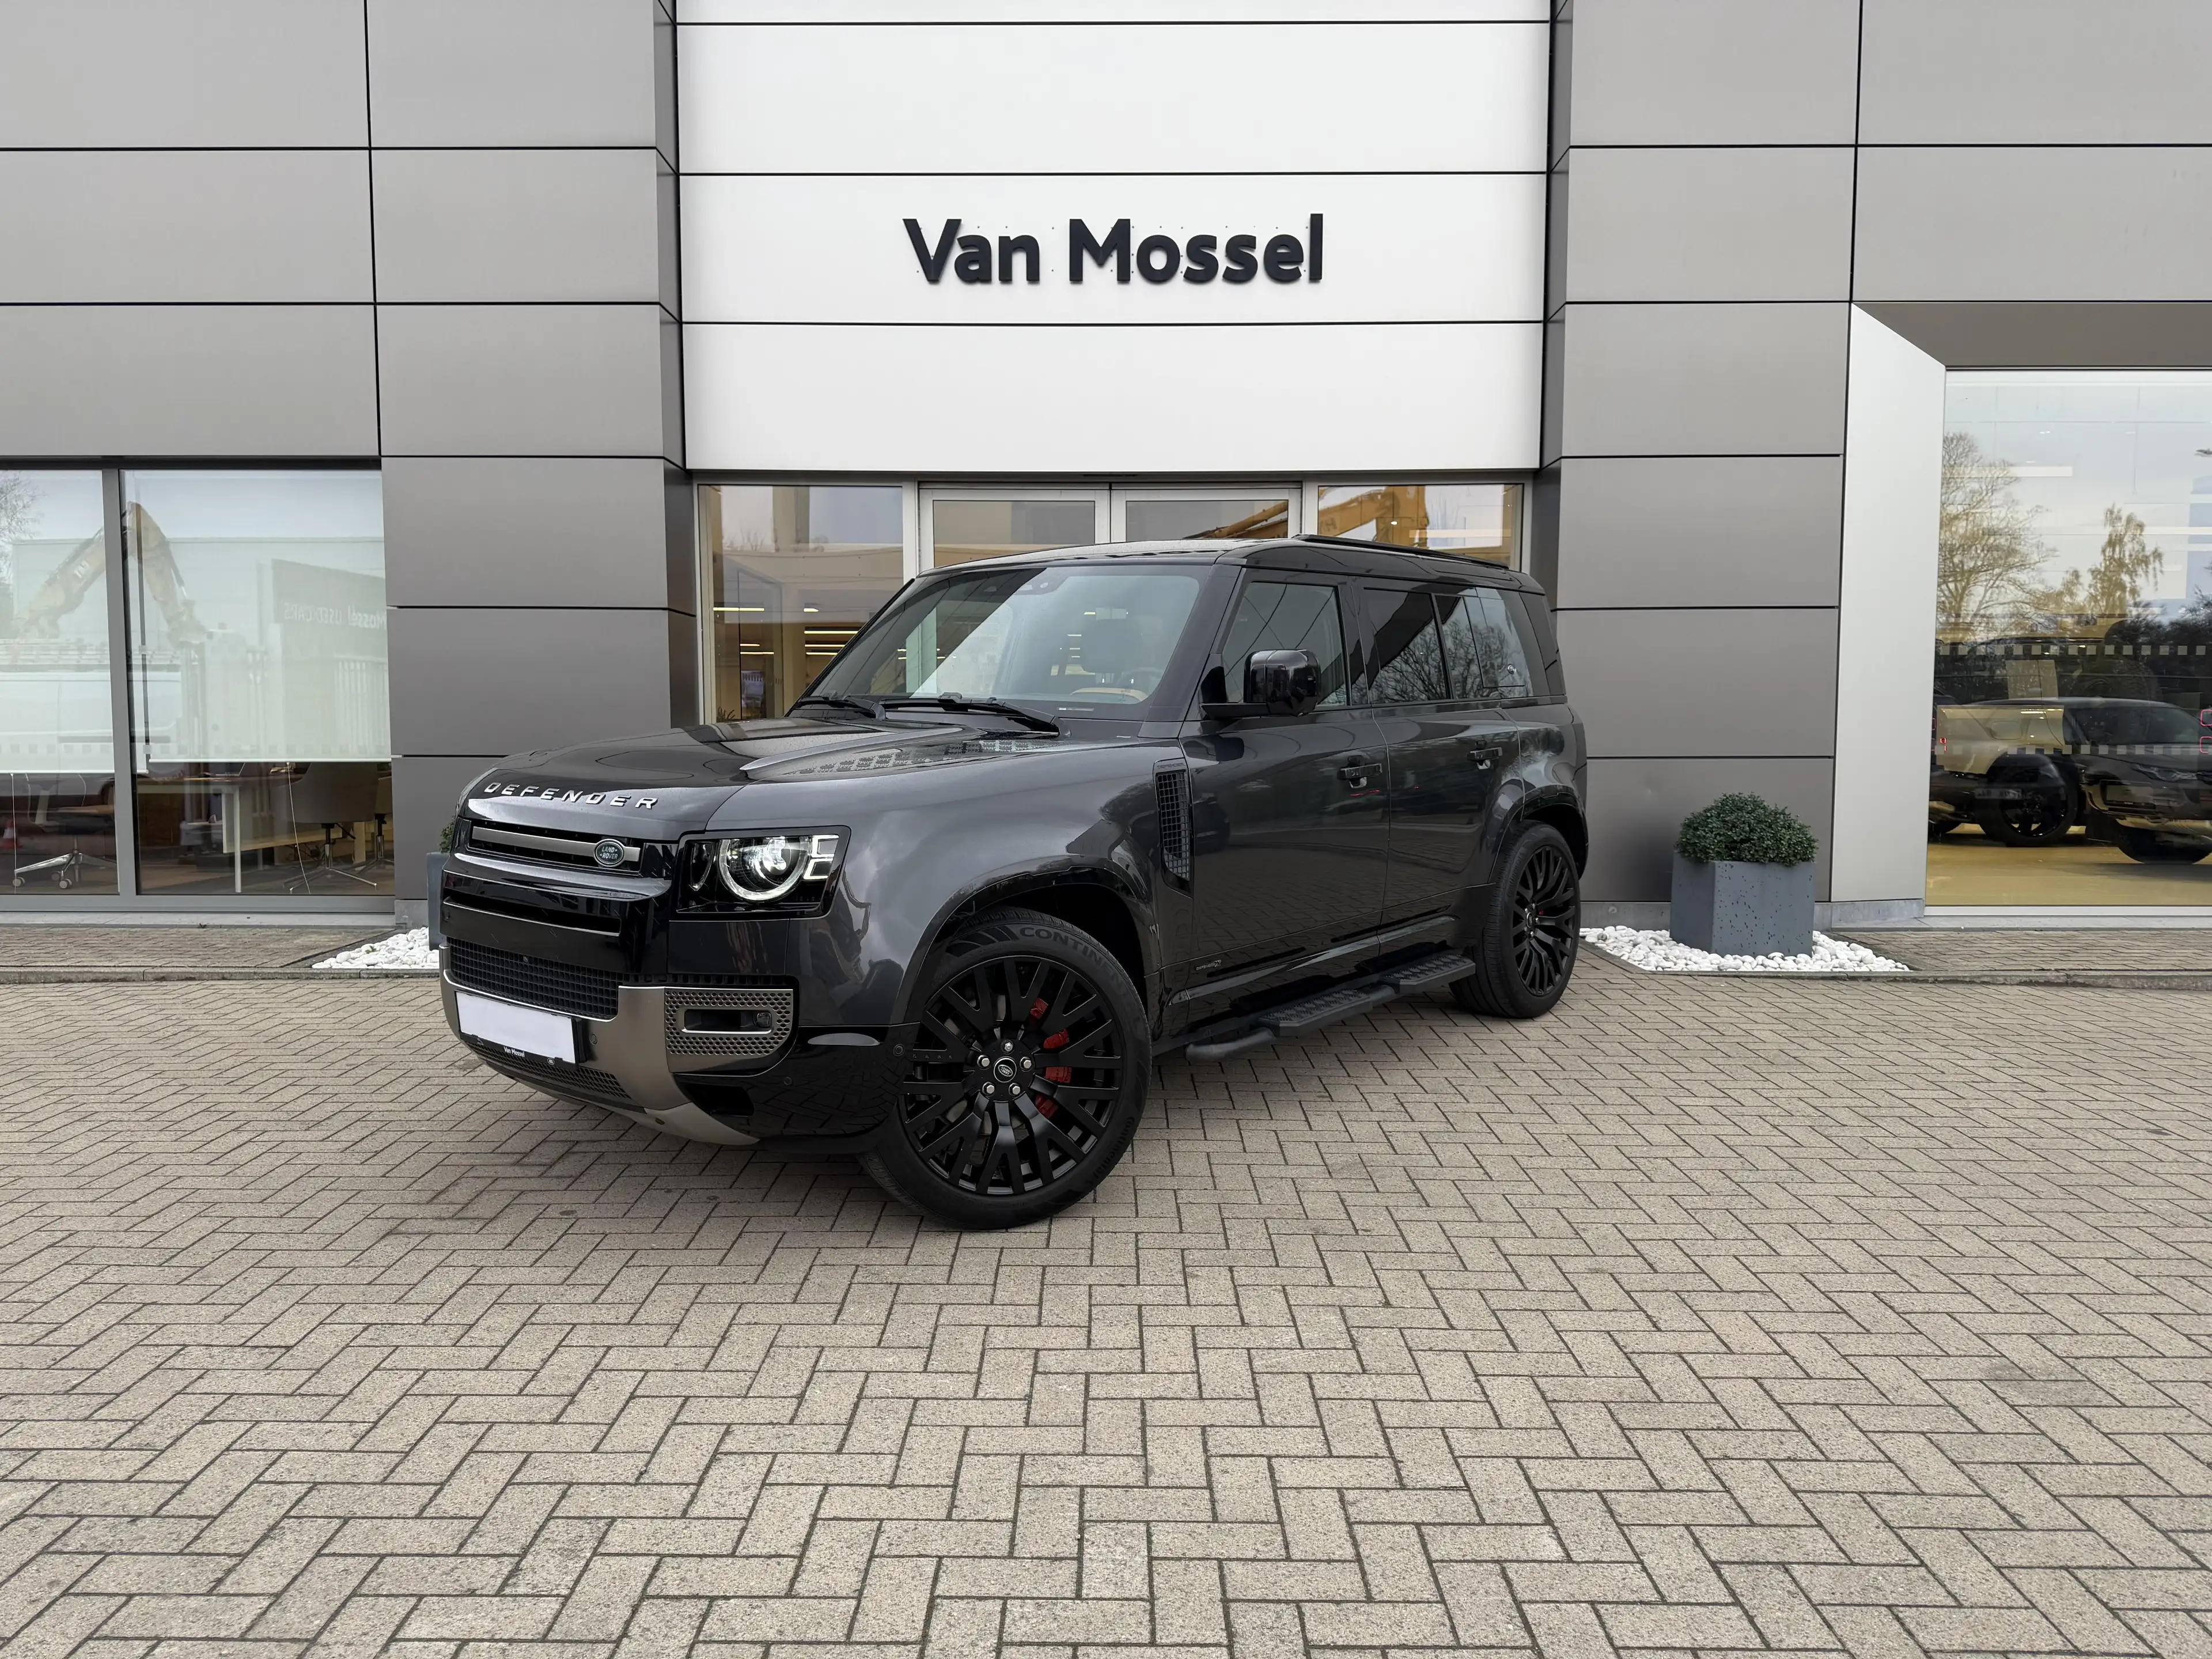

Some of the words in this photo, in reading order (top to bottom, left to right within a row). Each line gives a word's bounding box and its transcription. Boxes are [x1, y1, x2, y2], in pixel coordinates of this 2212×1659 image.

[902, 218, 1040, 285] Van
[1069, 213, 1324, 285] Mossel
[484, 782, 658, 809] DEFENDER
[1020, 927, 1142, 1024] CONTINENL
[512, 1048, 525, 1057] Mossel
